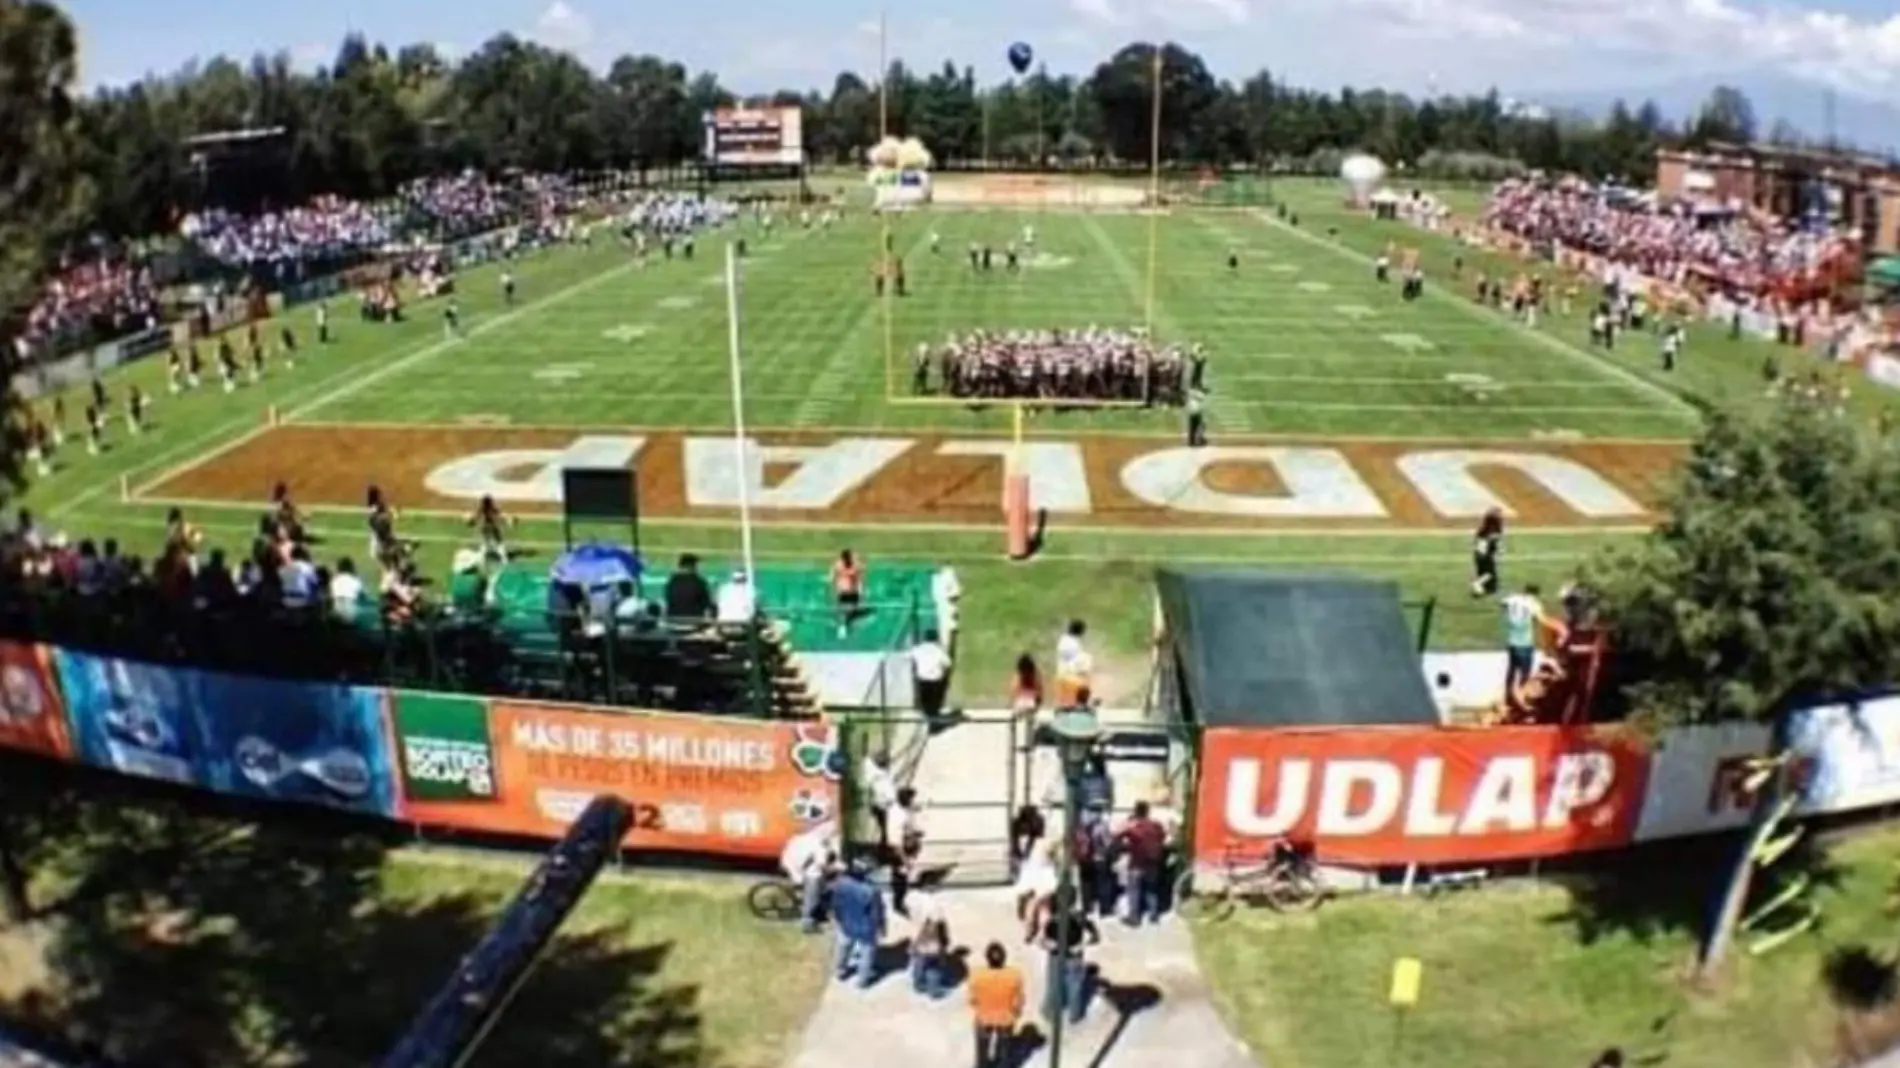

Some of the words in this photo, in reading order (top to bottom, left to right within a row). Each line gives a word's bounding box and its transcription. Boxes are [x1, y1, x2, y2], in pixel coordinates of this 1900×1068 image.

[424, 435, 1647, 517] UDLAP
[572, 724, 602, 757] DE
[608, 730, 642, 759] 35
[646, 735, 774, 772] MILLONES
[1224, 752, 1614, 837] UDLAP
